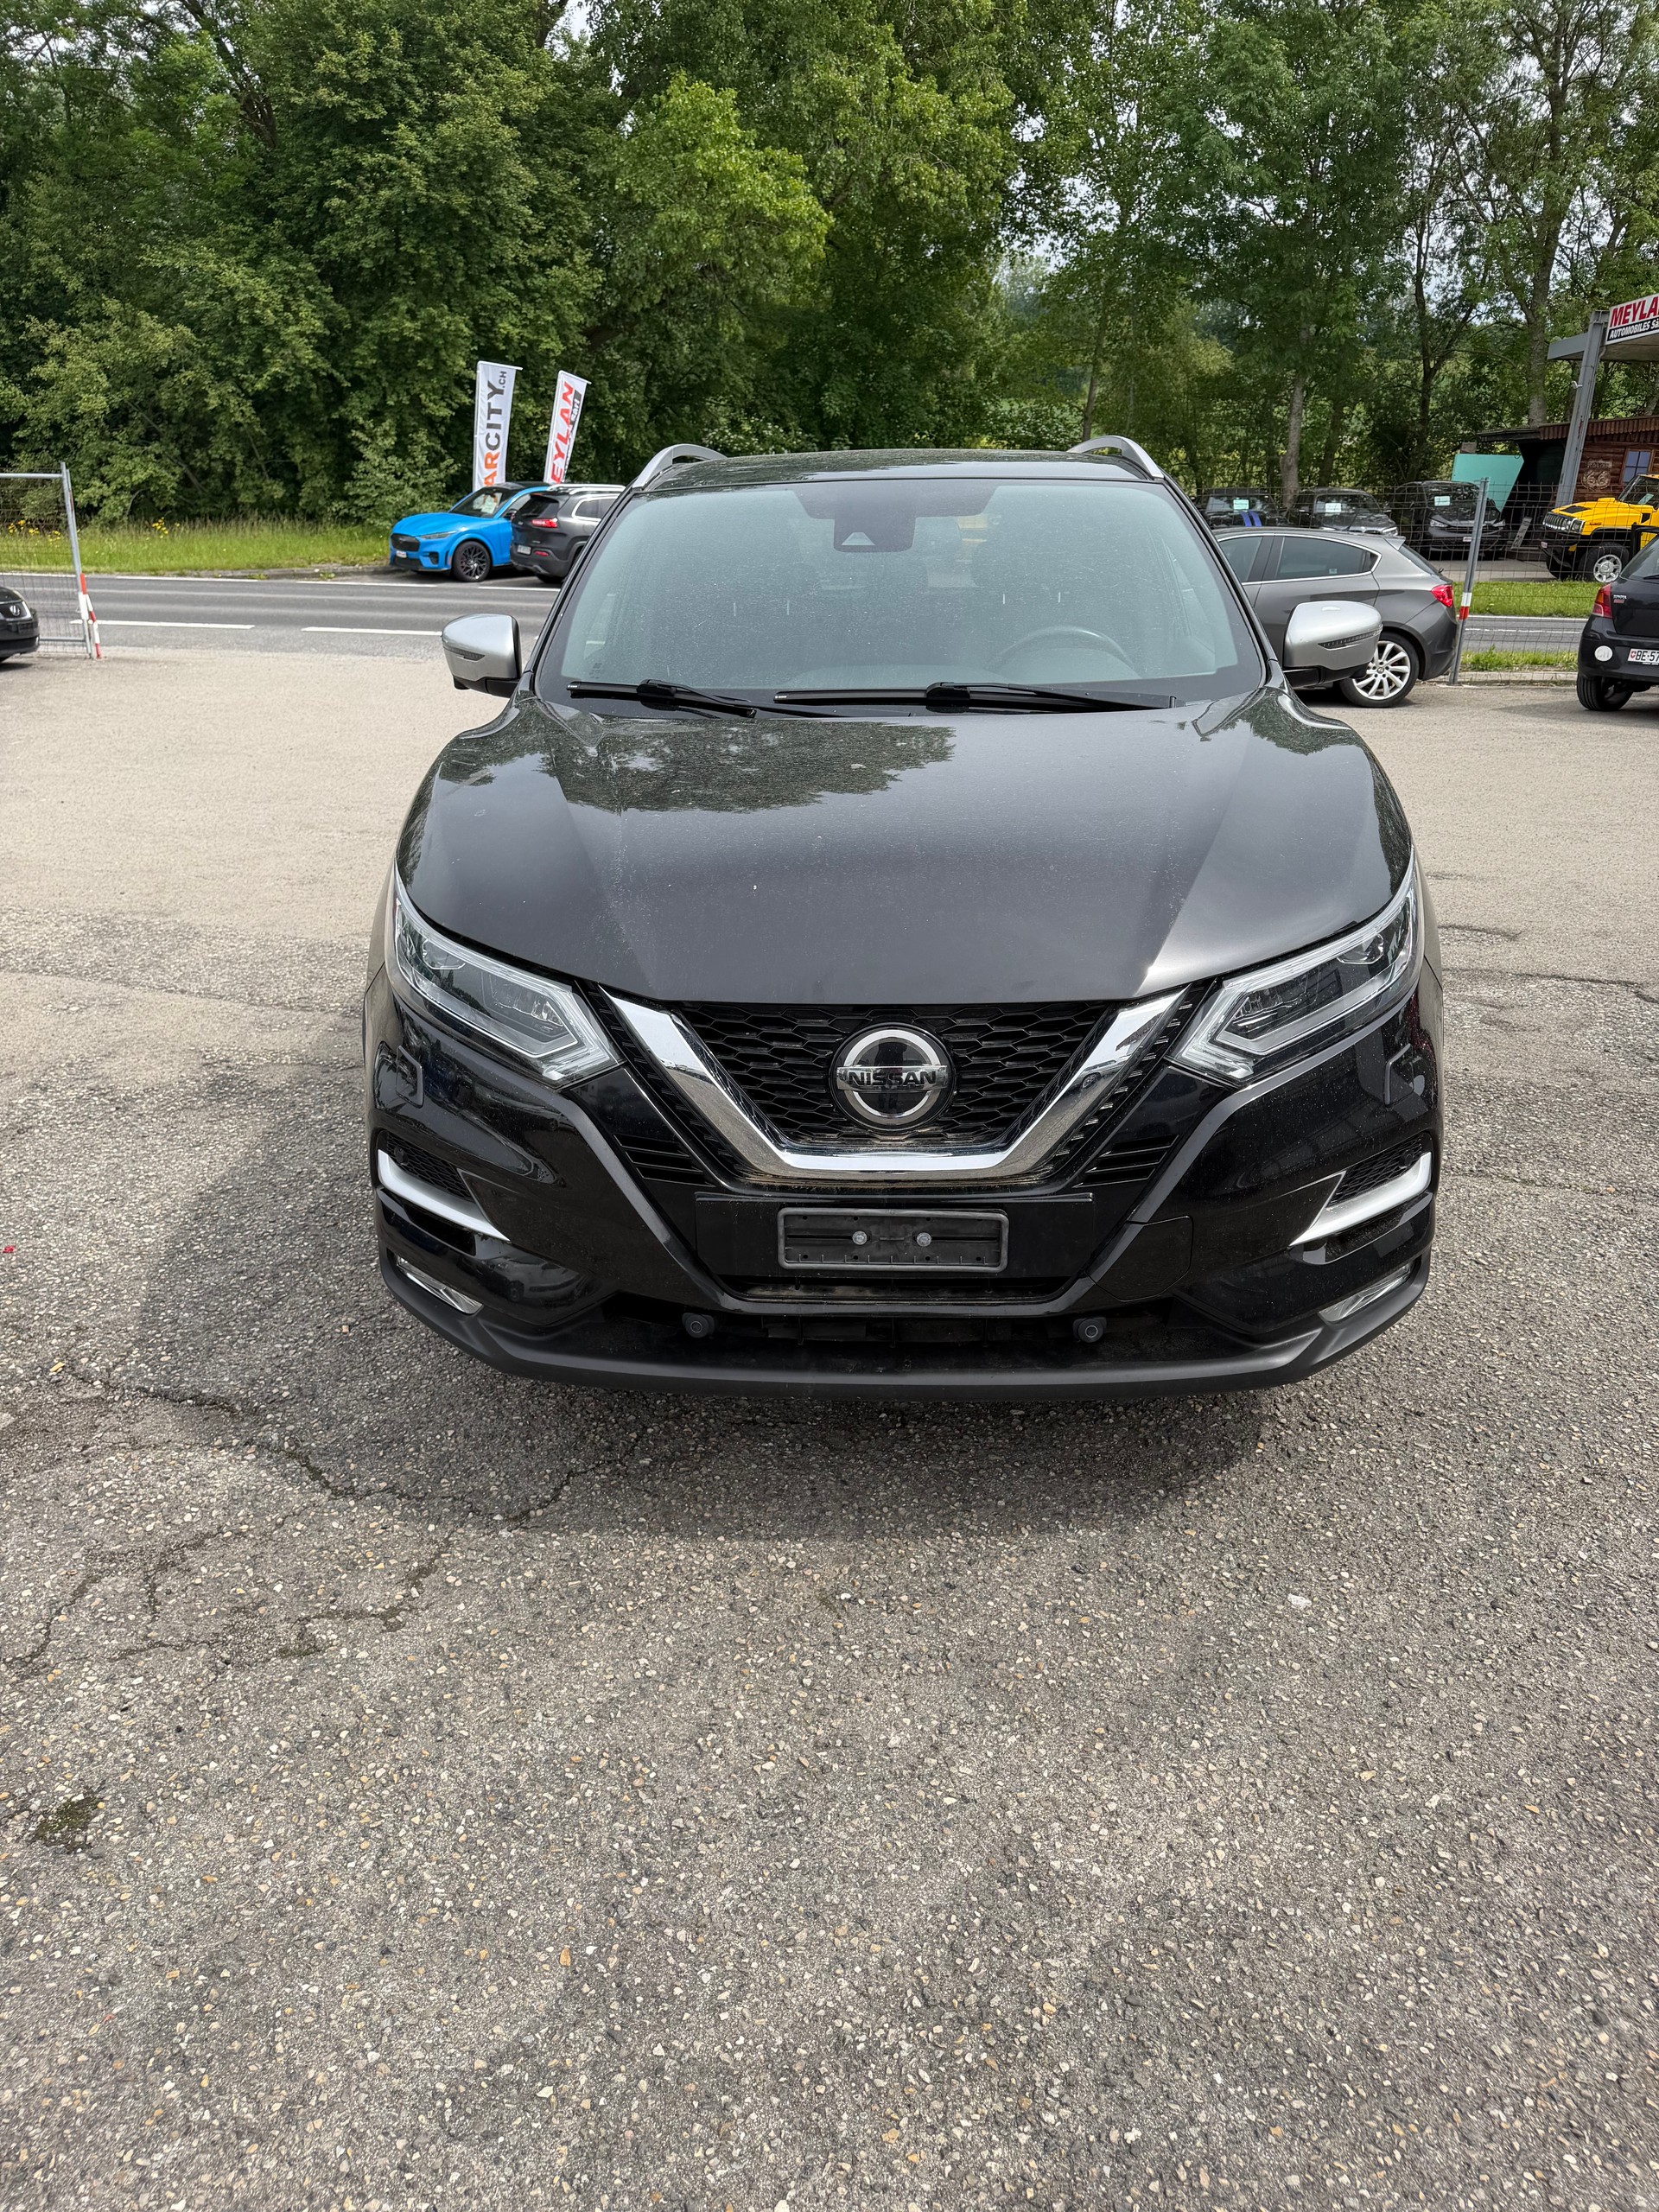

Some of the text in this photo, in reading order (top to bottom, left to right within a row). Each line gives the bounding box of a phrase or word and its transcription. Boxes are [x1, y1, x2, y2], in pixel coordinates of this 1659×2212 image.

[1610, 296, 1659, 327] MEYLA
[1609, 321, 1651, 340] AUTOMOBILES
[849, 1071, 937, 1086] NISSAN
